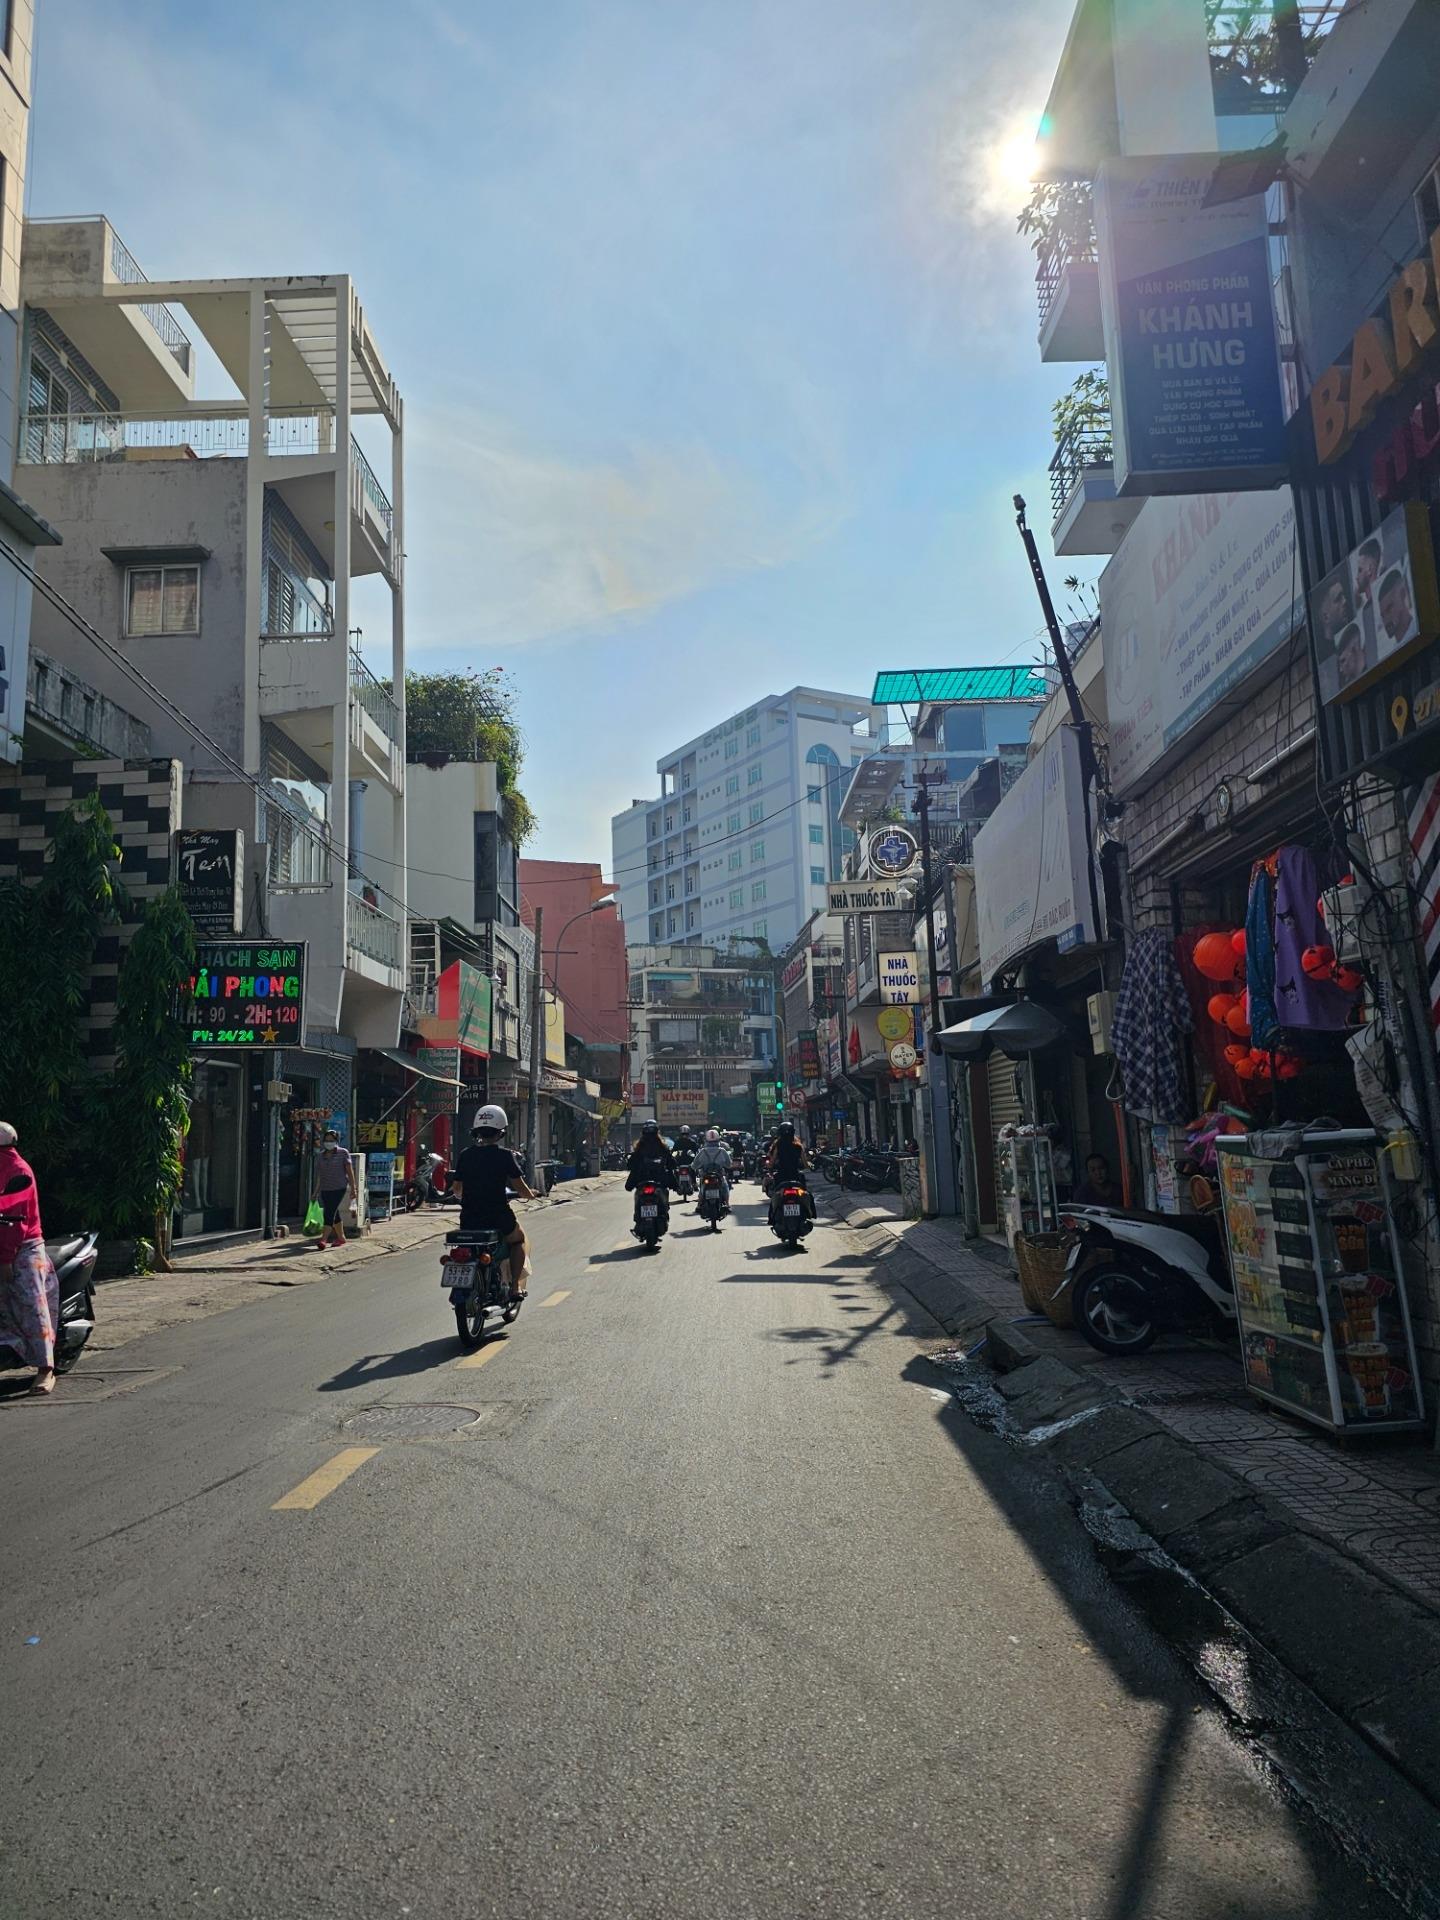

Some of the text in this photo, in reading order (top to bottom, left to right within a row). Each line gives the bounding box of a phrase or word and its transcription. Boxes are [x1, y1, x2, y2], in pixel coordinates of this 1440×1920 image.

[1138, 297, 1252, 334] KHÁNH
[1153, 336, 1245, 369] HƯNG
[831, 887, 897, 909] NHÀ THUỐC TÂY
[200, 947, 296, 970] HÁCH SẠN
[888, 956, 908, 969] NHÀ
[882, 971, 917, 986] THUỐC
[891, 991, 909, 1003] TÂY
[209, 1006, 226, 1023] 90
[244, 1004, 272, 1024] 2H:
[275, 1006, 298, 1023] 120
[192, 1029, 255, 1042] PV: 24/24
